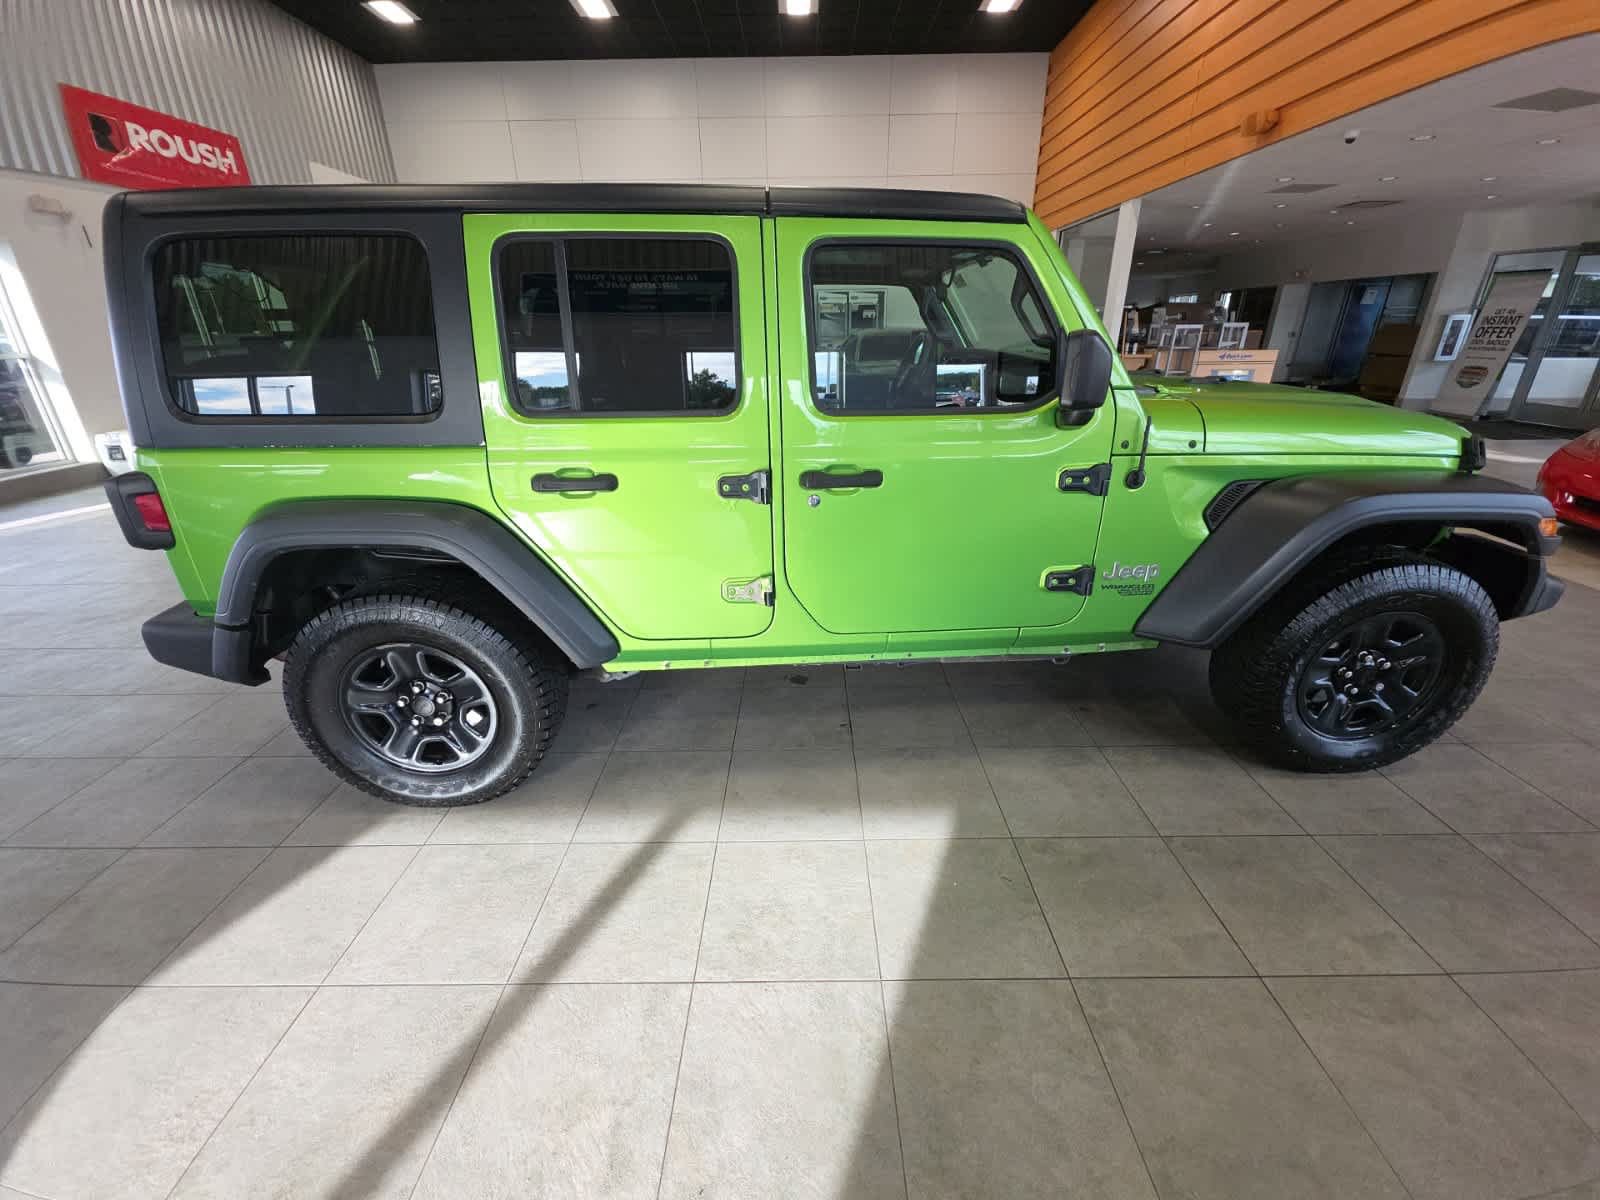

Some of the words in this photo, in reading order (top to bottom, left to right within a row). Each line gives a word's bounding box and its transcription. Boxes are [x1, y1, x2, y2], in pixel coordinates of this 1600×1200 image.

[124, 120, 240, 175] ROUSH
[1481, 315, 1525, 326] INSTANT
[1475, 326, 1517, 339] OFFER
[1103, 560, 1160, 582] Jeep
